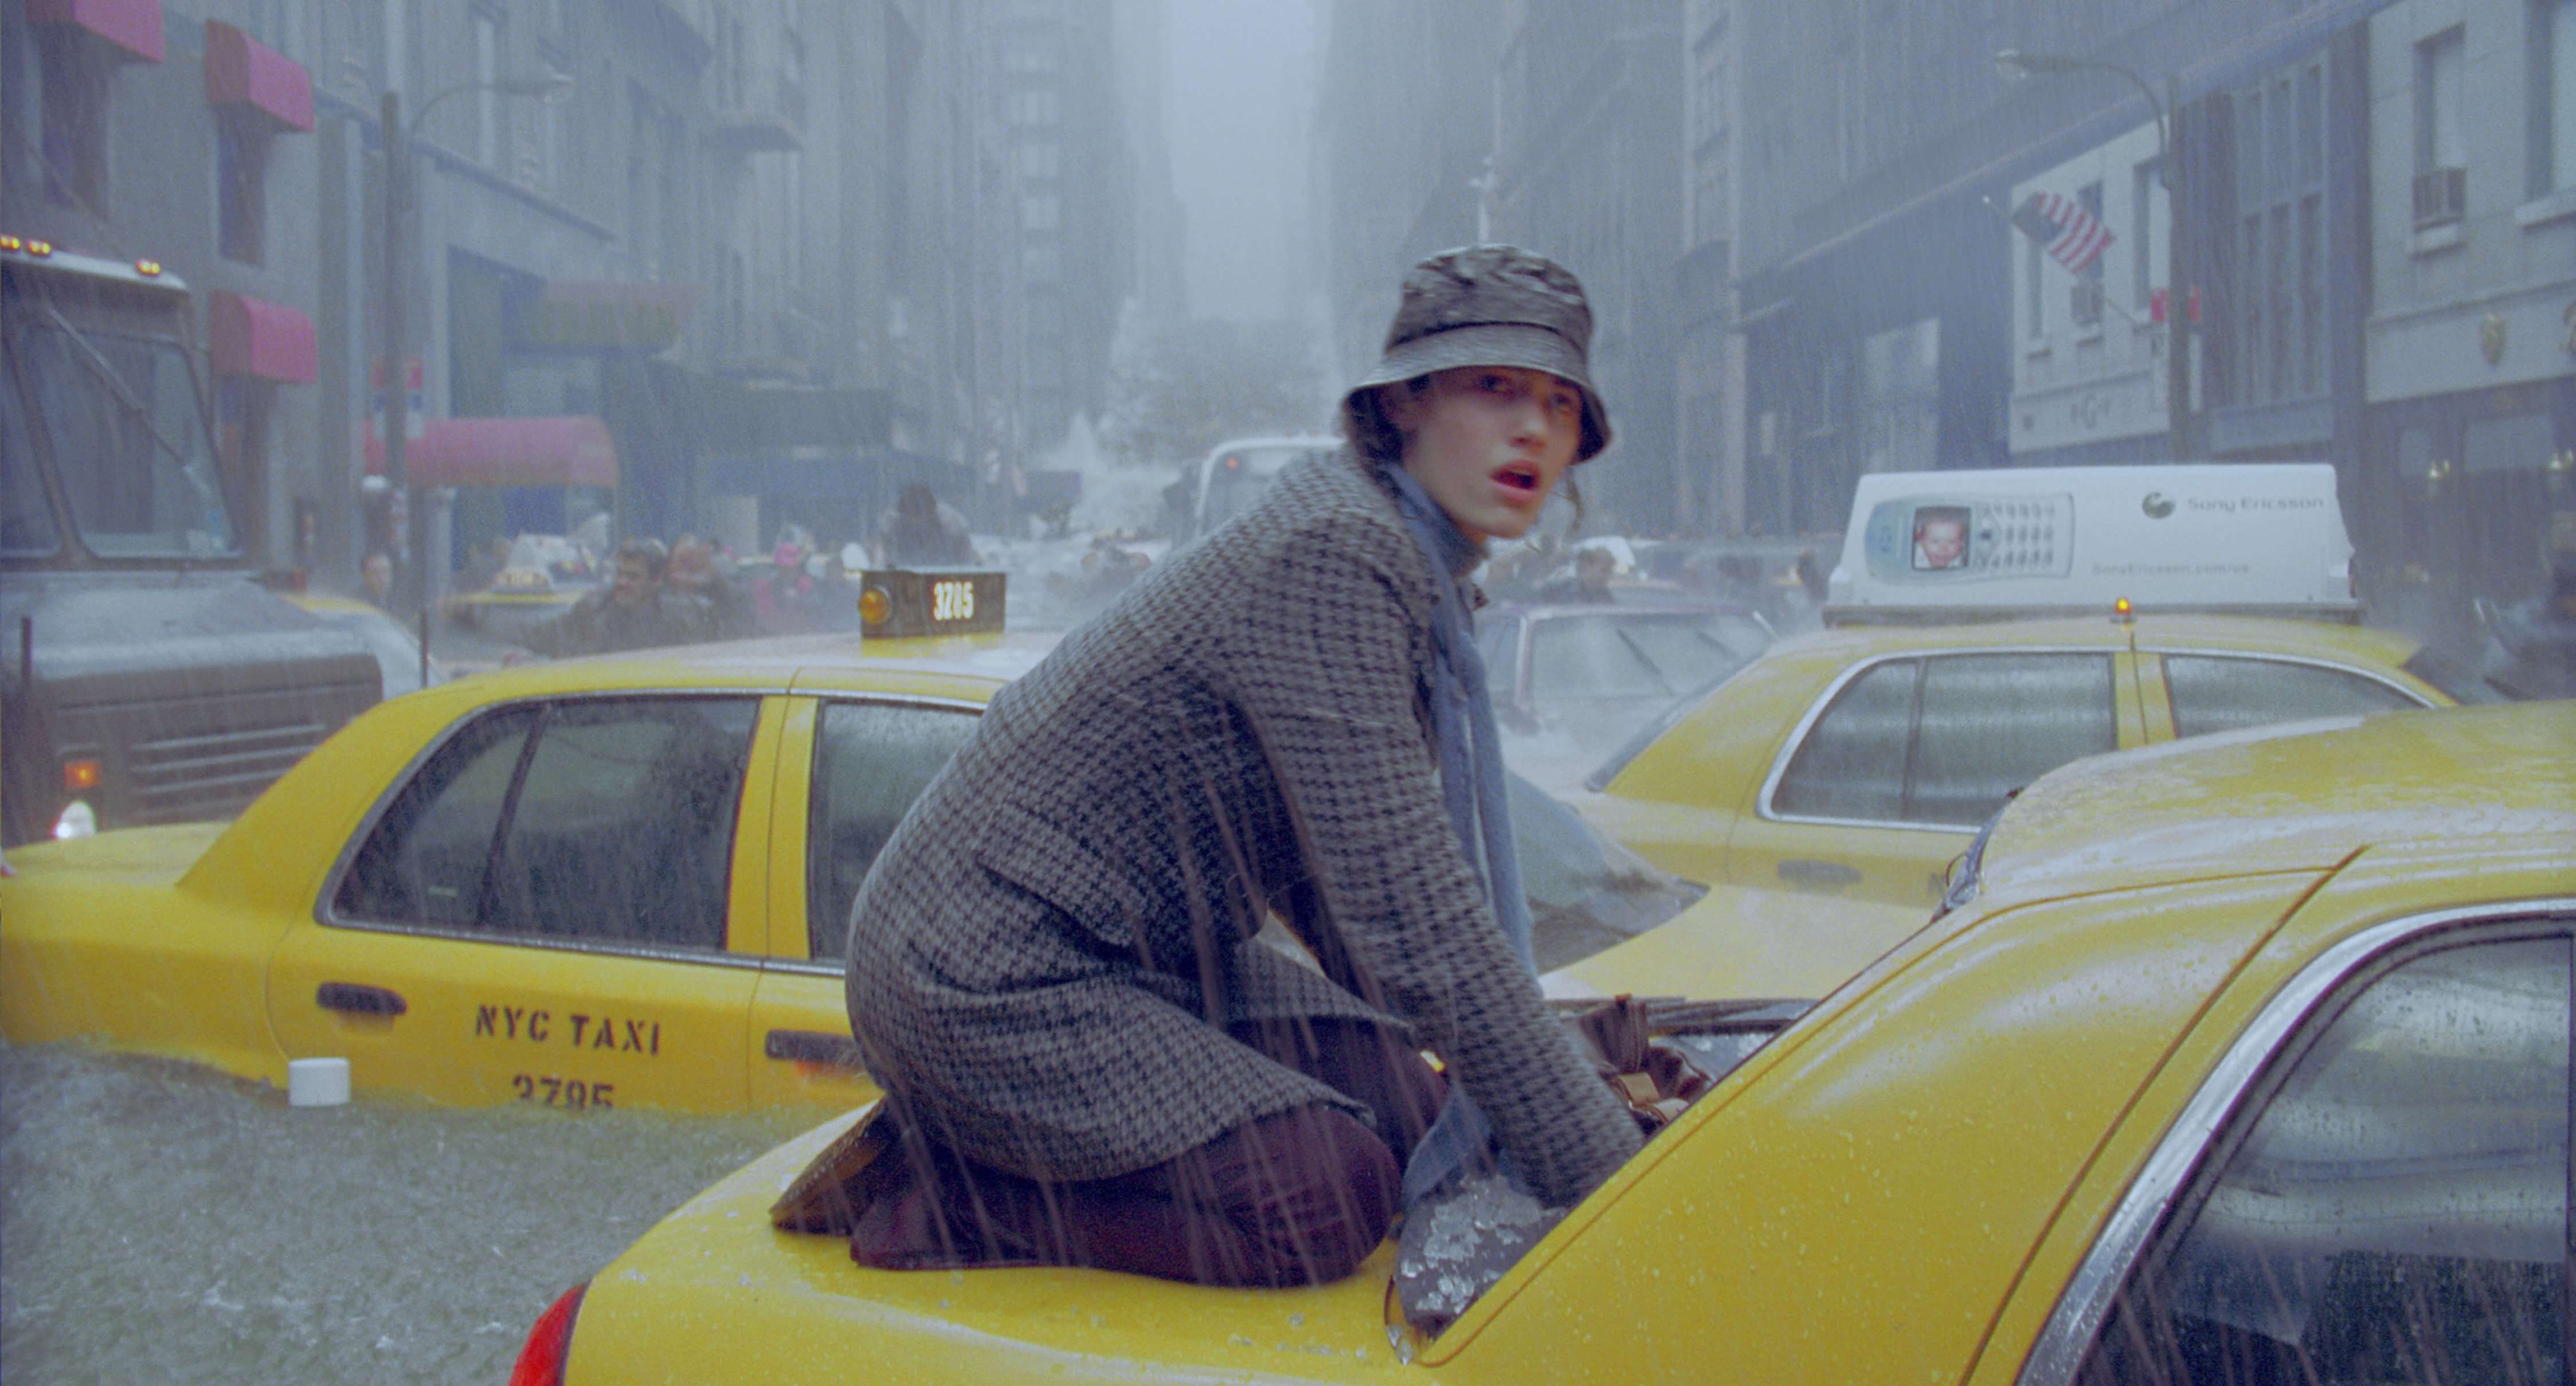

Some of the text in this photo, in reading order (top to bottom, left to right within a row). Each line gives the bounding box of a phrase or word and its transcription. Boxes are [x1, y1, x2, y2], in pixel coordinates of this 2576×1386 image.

[2187, 494, 2324, 514] Sony Ericsson
[475, 1004, 660, 1056] NYC TAXI
